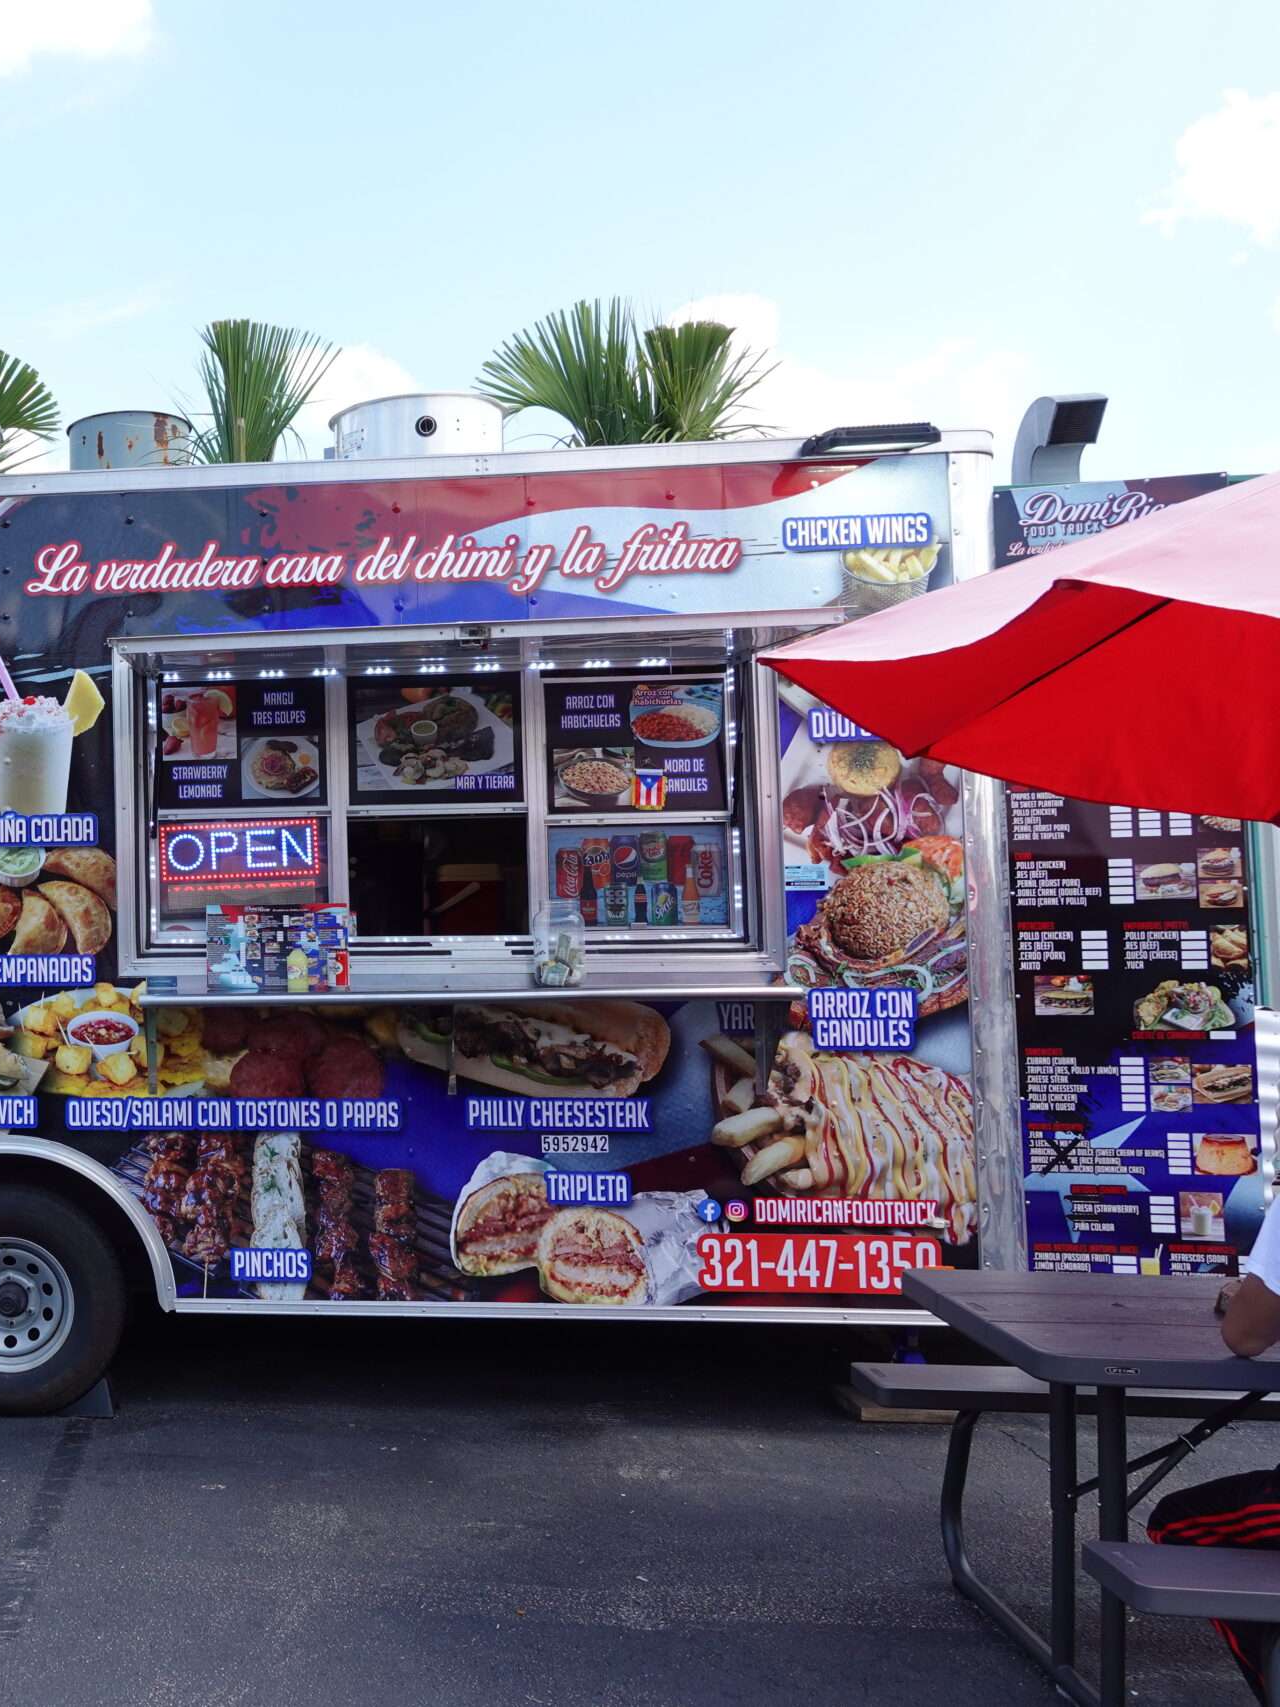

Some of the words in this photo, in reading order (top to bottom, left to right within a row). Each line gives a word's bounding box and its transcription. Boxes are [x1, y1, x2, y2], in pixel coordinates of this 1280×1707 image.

[785, 517, 862, 547] CHICKEN
[865, 514, 928, 544] WINGS
[1023, 526, 1056, 537] FOOD
[1062, 522, 1102, 535] TRUCK
[27, 543, 87, 593] La
[95, 542, 260, 590] verdadera
[265, 553, 343, 584] casa
[356, 536, 417, 583] del
[415, 534, 514, 581] chimi
[512, 544, 552, 592] y
[561, 524, 605, 576] la
[597, 521, 740, 590] fritura
[263, 691, 293, 706] MANGU
[566, 696, 594, 709] ARROZ
[596, 695, 615, 708] CON
[252, 711, 273, 725] TRES
[274, 710, 306, 724] GOLPES
[561, 714, 621, 729] HABICHUELAS
[172, 765, 228, 780] STRAWBERRY
[664, 758, 691, 773] MORO
[693, 758, 704, 772] DE
[179, 784, 222, 799] LEMONADE
[456, 775, 476, 789] MAR
[478, 775, 485, 789] Y
[486, 774, 515, 789] TIERRA
[30, 816, 94, 842] COLADA
[167, 827, 313, 871] OPEN
[812, 991, 871, 1018] ARROZ
[876, 991, 913, 1017] CON
[817, 1020, 910, 1046] GANDULES
[68, 1098, 193, 1128] QUESO/SALAMI
[197, 1102, 232, 1127] CON
[235, 1101, 320, 1127] TOSTONES
[325, 1102, 337, 1127] O
[342, 1101, 399, 1127] PAPAS
[468, 1100, 524, 1126] PHILLY
[530, 1100, 649, 1128] CHEESESTEAK
[542, 1135, 608, 1152] 5952942
[548, 1174, 627, 1201] TRIPLETA
[755, 1199, 937, 1225] DOMIRICANFOODTRUCK
[235, 1251, 308, 1277] PINCHOS
